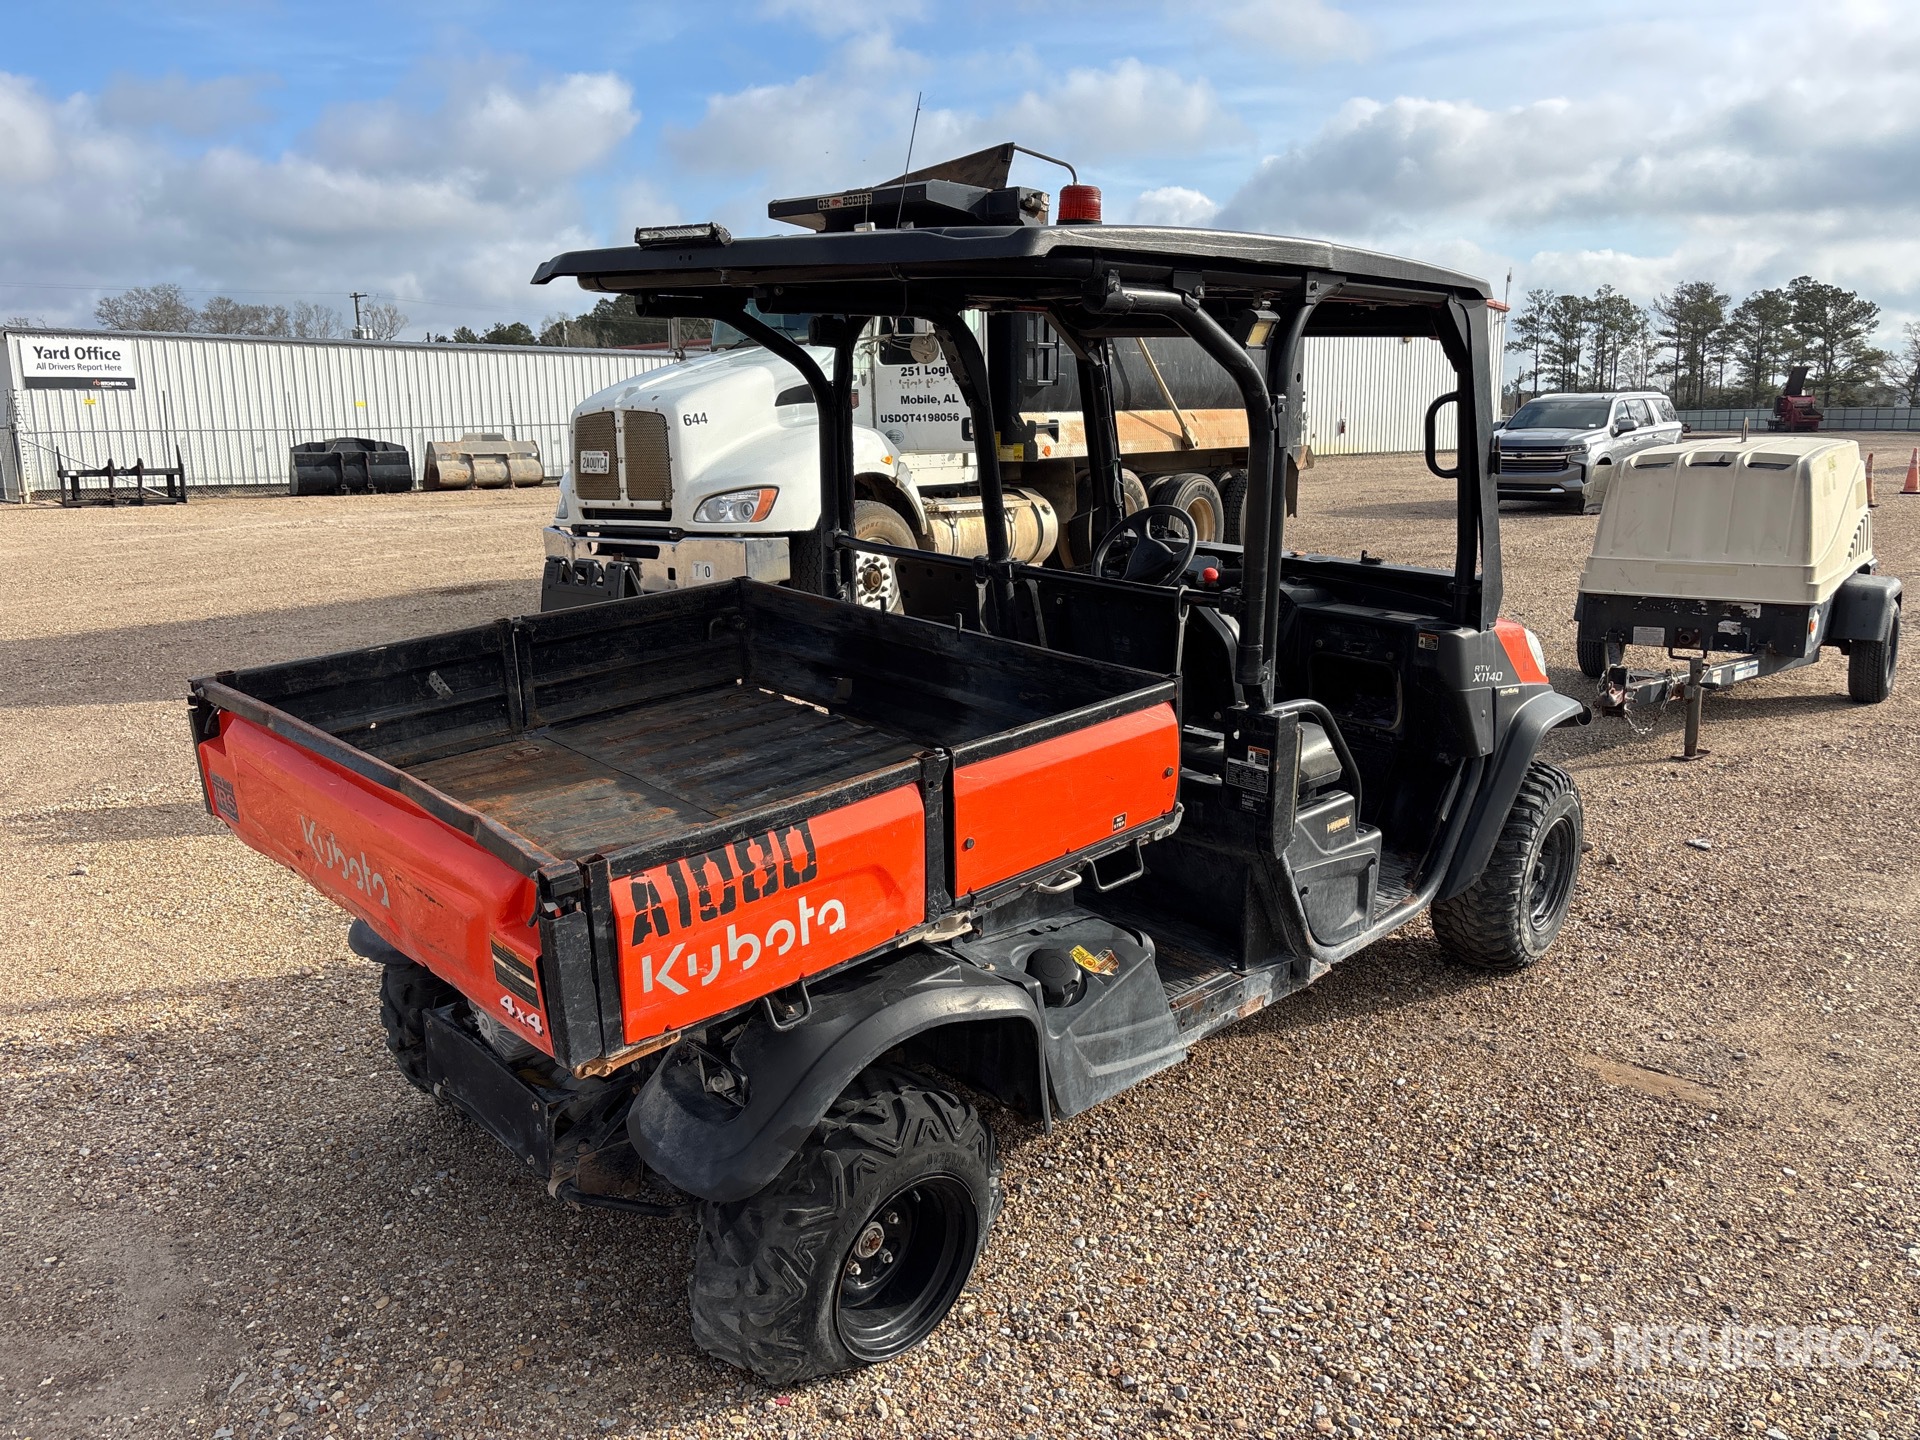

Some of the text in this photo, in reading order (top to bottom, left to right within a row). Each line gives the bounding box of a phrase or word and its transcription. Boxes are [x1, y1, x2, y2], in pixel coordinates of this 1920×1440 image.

[842, 194, 871, 206] BODIES
[33, 345, 121, 361] Yard Office
[36, 362, 122, 373] All Drivers Report Here
[900, 365, 951, 377] 251 Logi
[900, 393, 960, 405] Mobile, AL
[683, 411, 709, 427] 644
[880, 412, 960, 423] USDOT4198056
[1474, 664, 1490, 672] RTV
[1472, 671, 1503, 682] X1140
[301, 815, 391, 909] Kubota
[641, 895, 846, 996] Kubota
[500, 995, 544, 1037] 4x4
